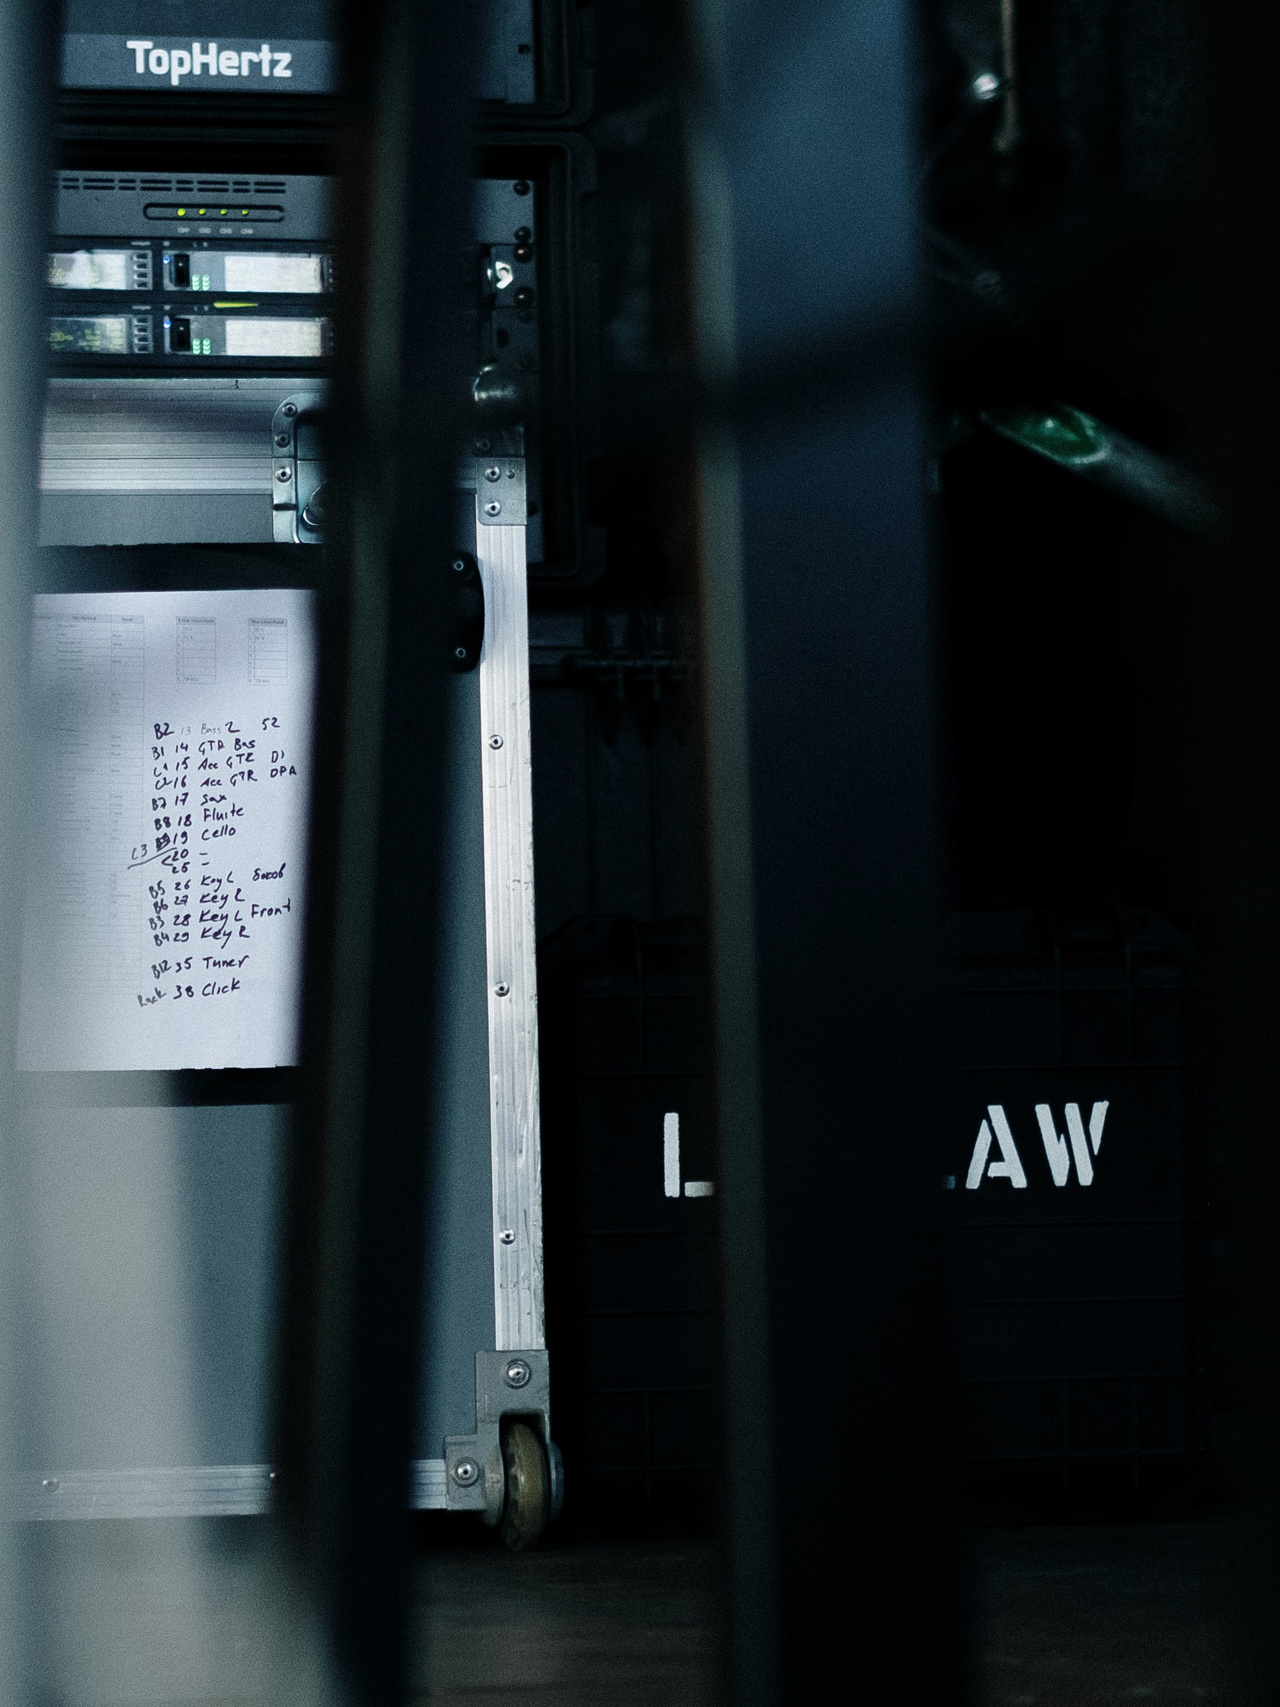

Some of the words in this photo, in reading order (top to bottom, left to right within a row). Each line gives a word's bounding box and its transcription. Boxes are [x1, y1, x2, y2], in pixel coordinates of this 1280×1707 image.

[126, 40, 292, 86] TopHertz
[153, 722, 175, 740] B2
[261, 717, 281, 731] 52
[175, 743, 189, 754] 14
[175, 756, 191, 771] 15
[173, 775, 188, 789] 16
[174, 792, 190, 806] 17
[154, 817, 172, 832] B8
[177, 814, 193, 827] 18
[173, 830, 189, 845] 19
[201, 824, 237, 842] Cello
[172, 848, 189, 862] 20
[174, 879, 192, 891] 26
[174, 895, 190, 906] 27
[199, 892, 230, 910] Key
[172, 913, 192, 927] 28
[199, 909, 229, 931] Key
[251, 897, 292, 919] Front
[173, 931, 190, 943] 29
[200, 926, 233, 950] Key
[239, 925, 251, 939] R
[175, 957, 194, 974] 35
[202, 955, 250, 970] Tuner
[173, 984, 195, 1000] 38
[201, 977, 241, 998] Click
[944, 1100, 1110, 1190] AW
